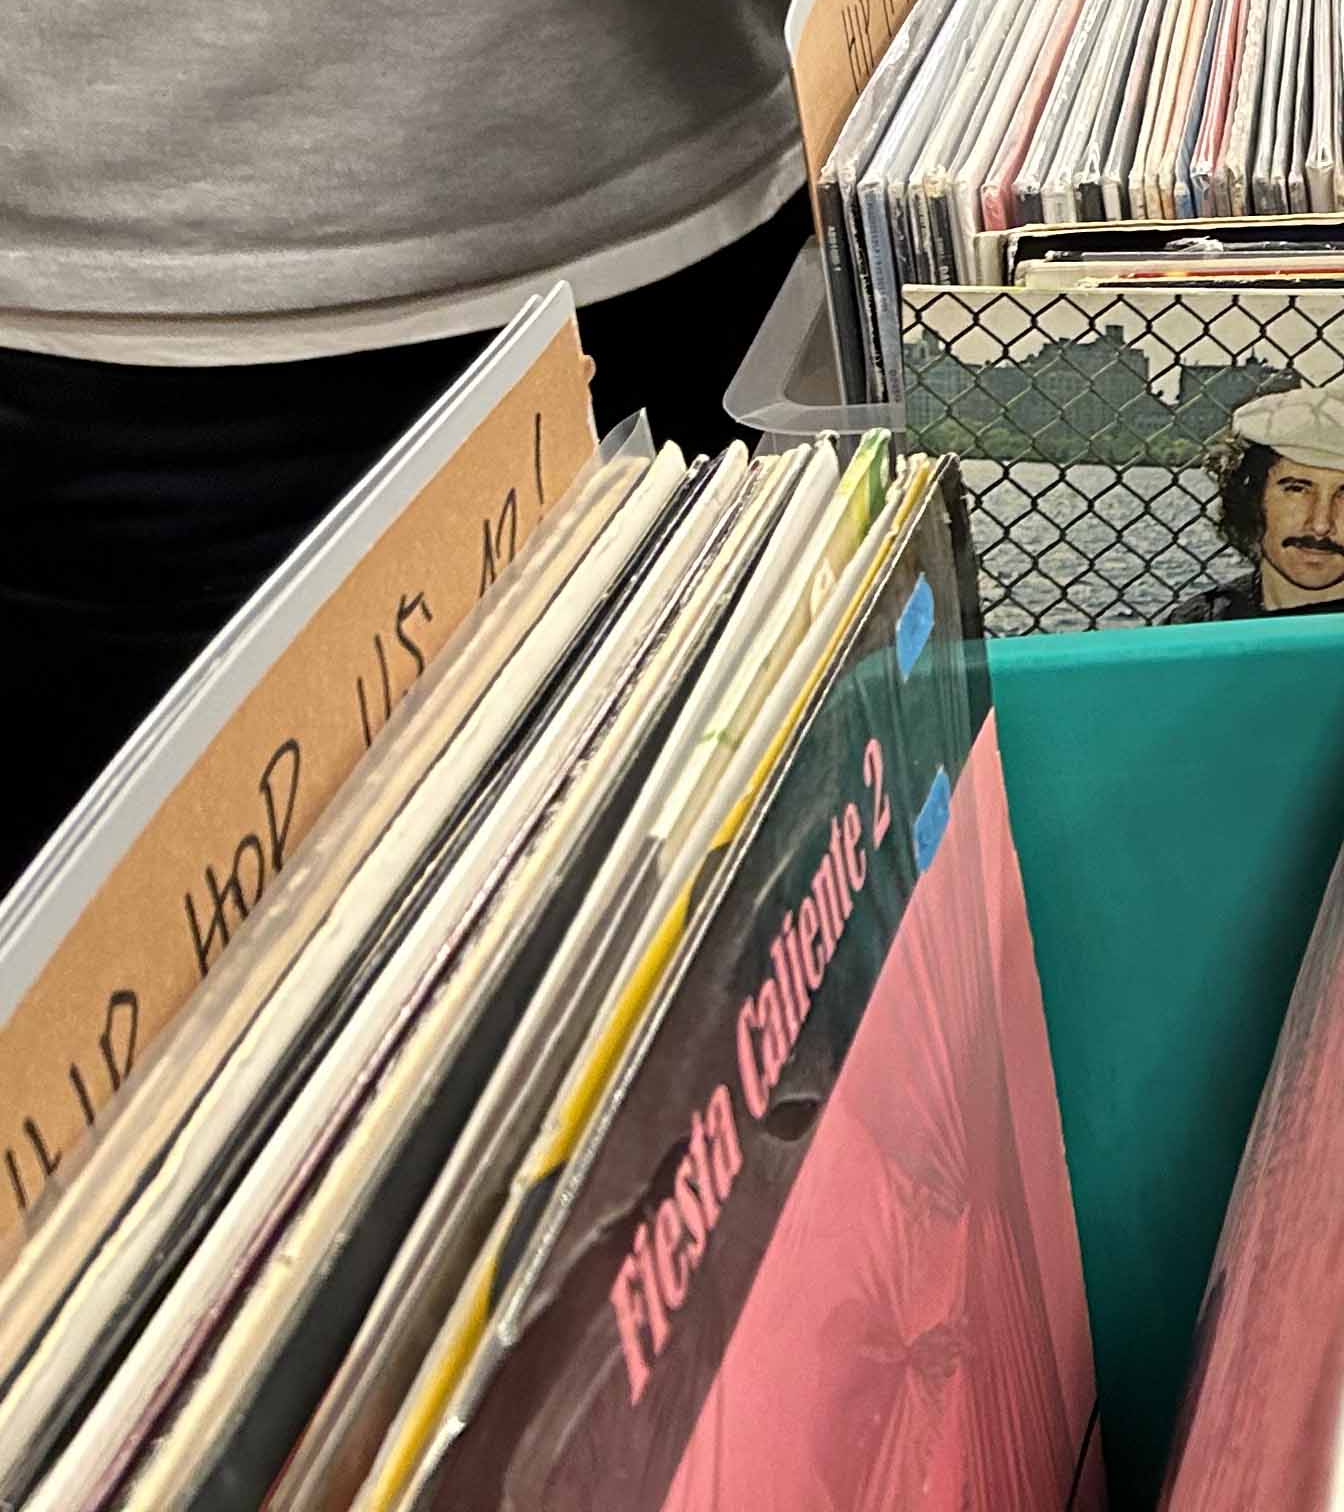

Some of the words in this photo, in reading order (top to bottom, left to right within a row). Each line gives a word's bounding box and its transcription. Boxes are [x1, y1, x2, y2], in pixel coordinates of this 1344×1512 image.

[610, 1083, 744, 1407] Fiesta
[736, 801, 868, 1120] Caliente
[862, 737, 892, 850] 2
